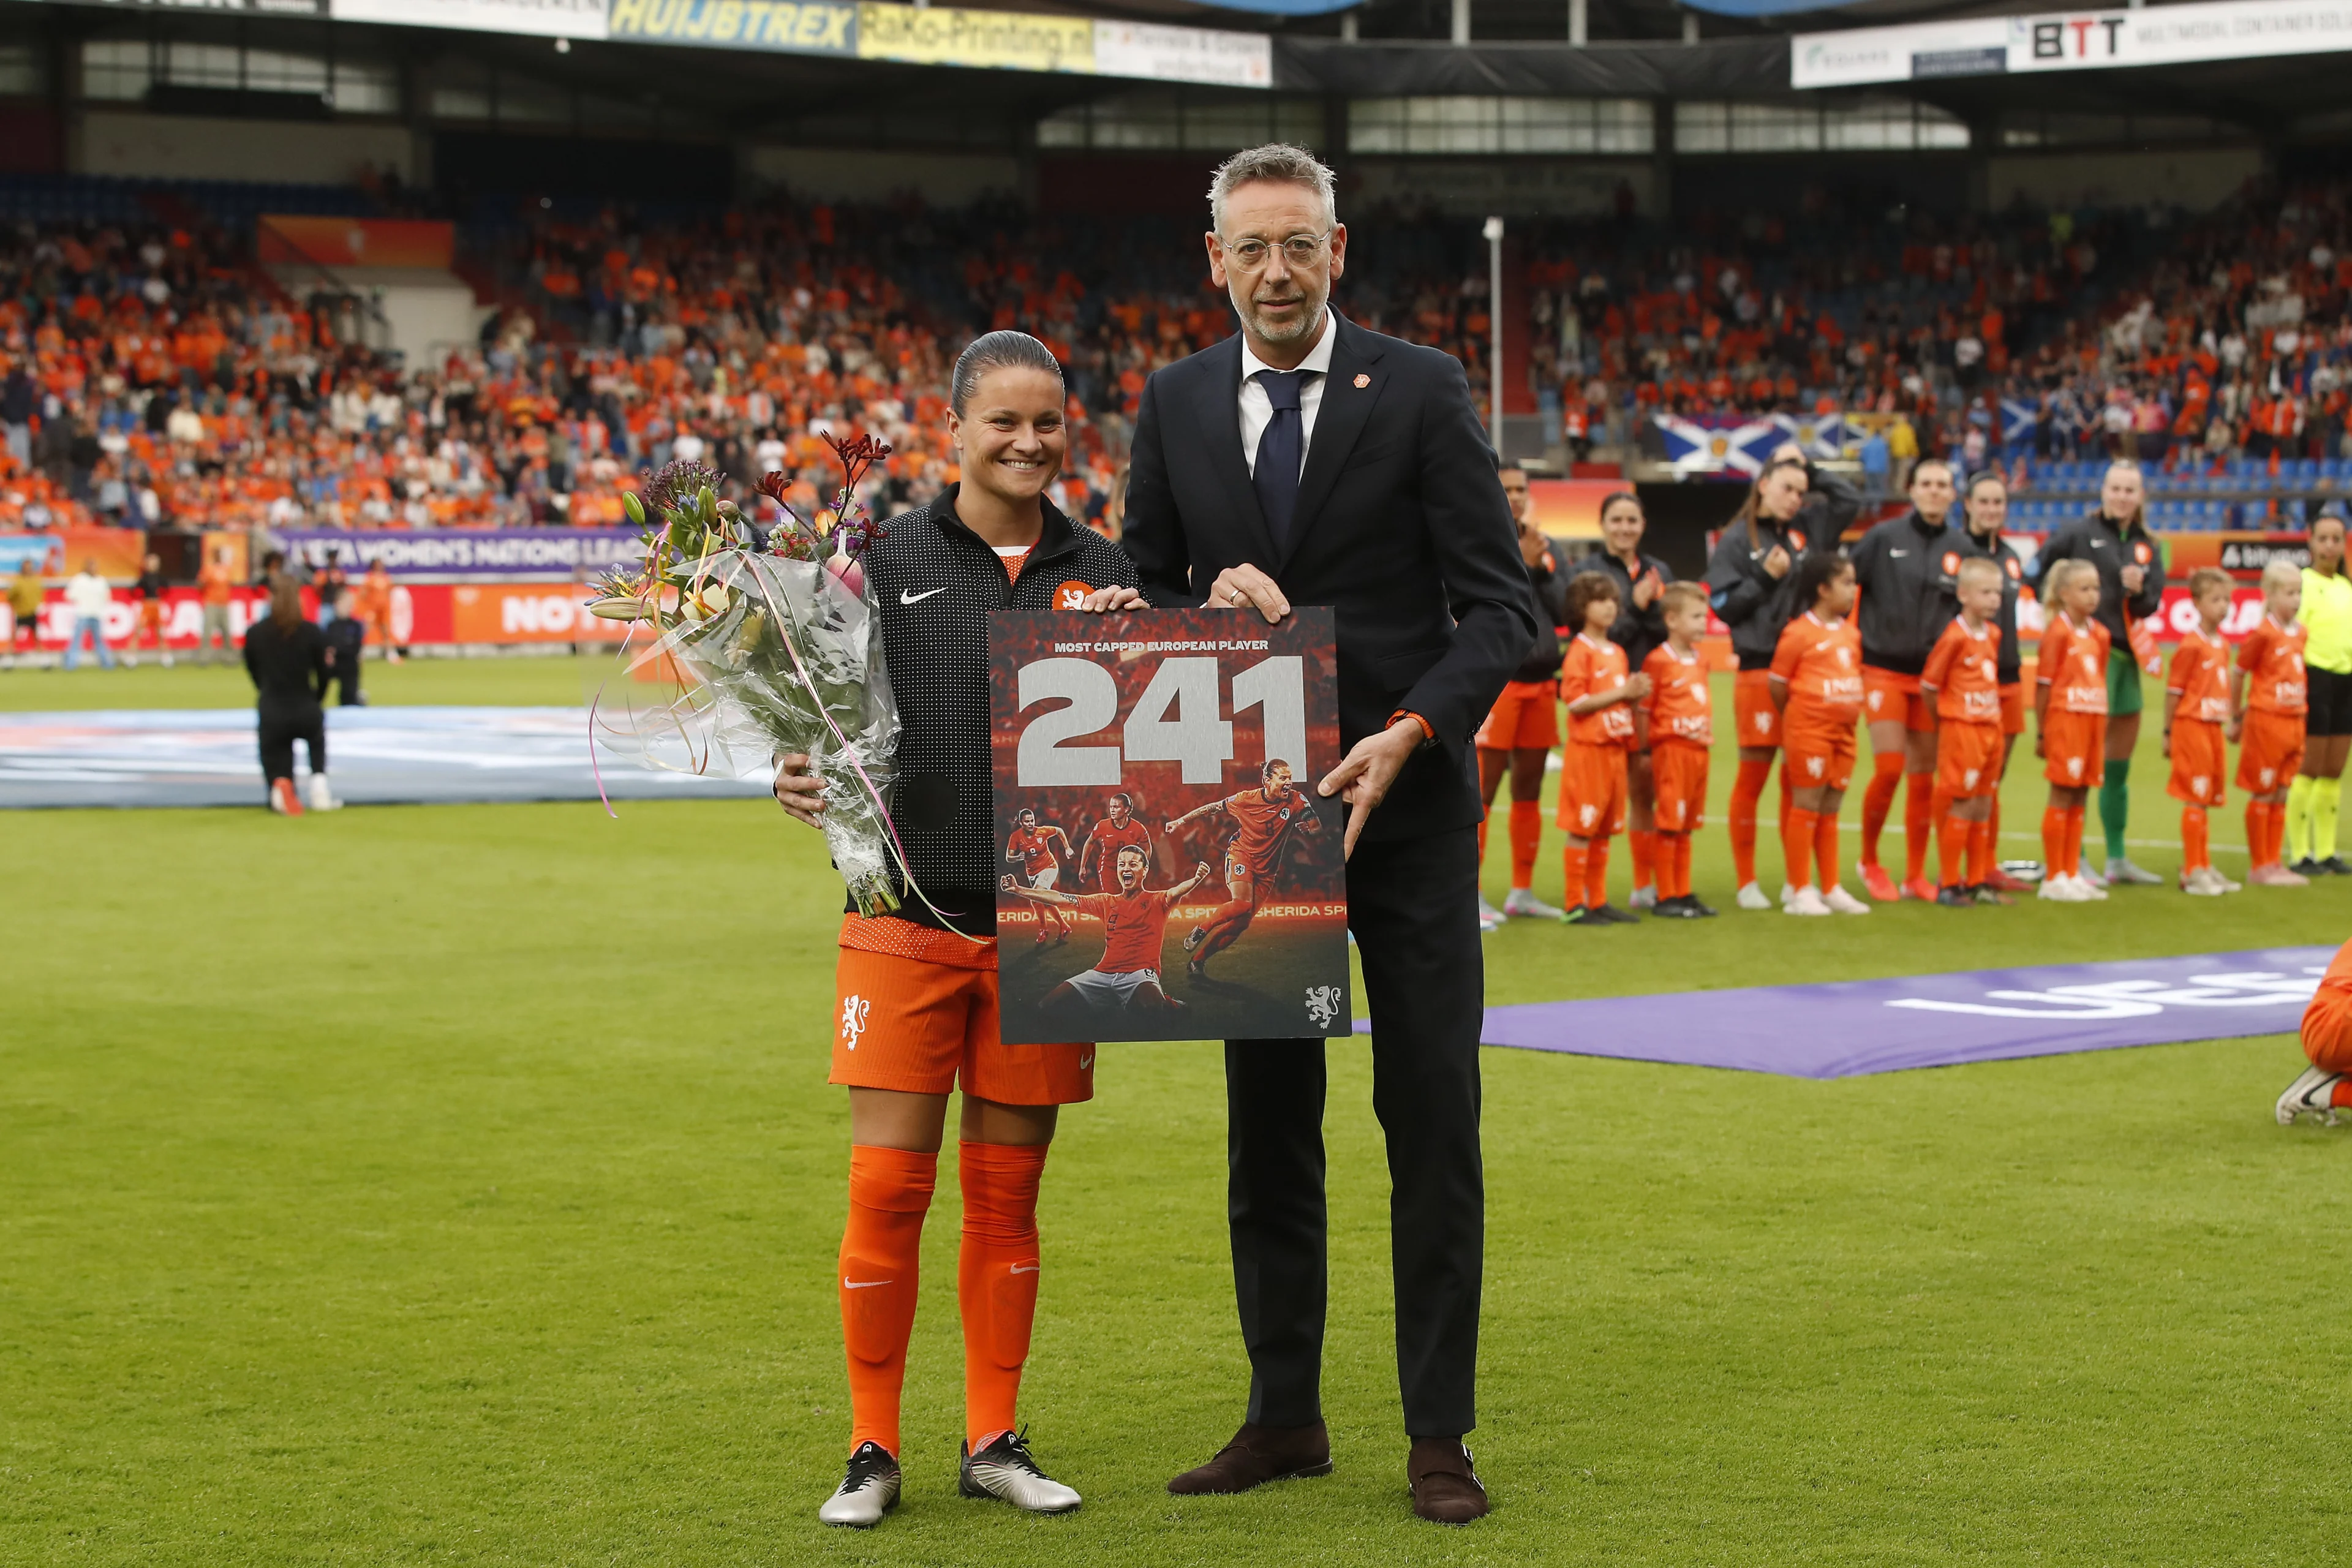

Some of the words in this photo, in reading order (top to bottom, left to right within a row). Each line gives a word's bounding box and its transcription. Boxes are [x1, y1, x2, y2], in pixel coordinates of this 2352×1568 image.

[610, 0, 853, 48] HUIJBTREX
[2034, 18, 2124, 58] BTT
[1054, 643, 1091, 653] MOST
[1093, 641, 1145, 652] CAPPED
[1147, 641, 1216, 651] EUROPEAN
[1218, 640, 1268, 650] PLAYER
[1017, 655, 1307, 787] 241
[1185, 908, 1218, 919] SPIT
